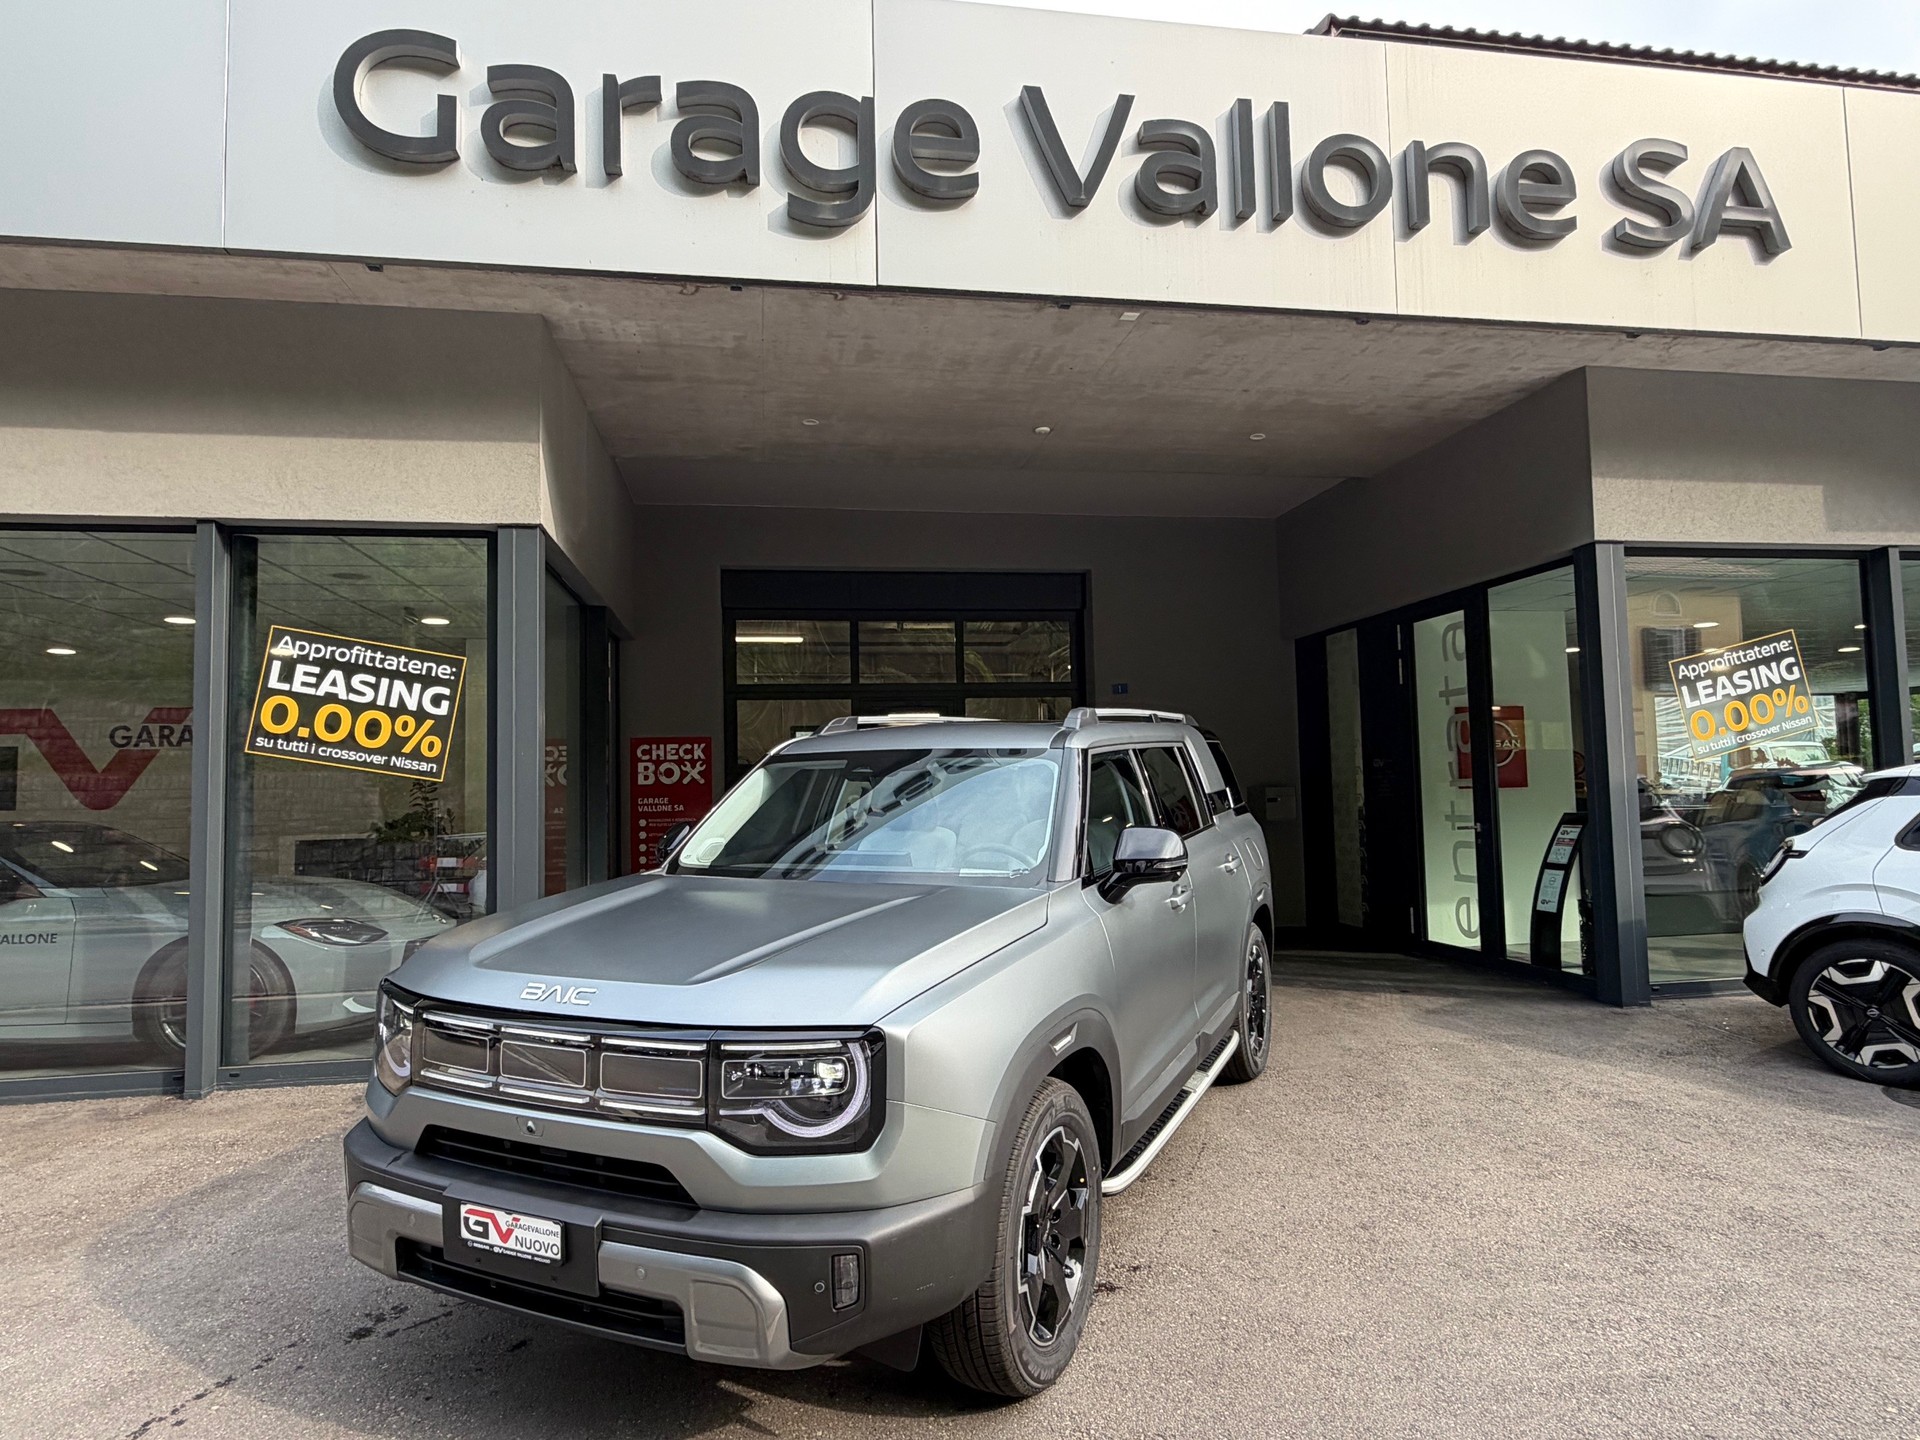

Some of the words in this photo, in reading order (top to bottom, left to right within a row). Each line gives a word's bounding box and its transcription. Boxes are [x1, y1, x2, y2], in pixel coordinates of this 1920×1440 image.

[333, 28, 980, 228] Garage
[1020, 84, 1578, 251] Vallone
[1606, 137, 1792, 258] SA
[277, 635, 457, 680] Approfittatene:
[1678, 639, 1794, 680] Approfittatene:
[267, 660, 451, 716] LEASING
[1681, 656, 1801, 709] LEASING
[260, 695, 442, 758] 0.00%
[1690, 684, 1809, 742] 0.00%
[636, 743, 706, 760] CHECK
[1697, 744, 1710, 754] su
[1710, 738, 1731, 751] tutti
[1736, 723, 1781, 743] crossover
[1782, 716, 1812, 730] Nissan
[255, 736, 274, 748] su
[276, 737, 309, 754] tutti
[311, 743, 316, 754] i
[318, 746, 388, 765] crossover
[390, 756, 437, 773] Nissan
[637, 760, 707, 785] BOX
[637, 804, 673, 812] VALLONE
[673, 804, 685, 812] SA
[638, 797, 669, 805] GARAGE
[520, 982, 598, 1006] BAIC
[505, 1220, 559, 1238] GARAGEVALLONE
[514, 1235, 560, 1256] NUOVO
